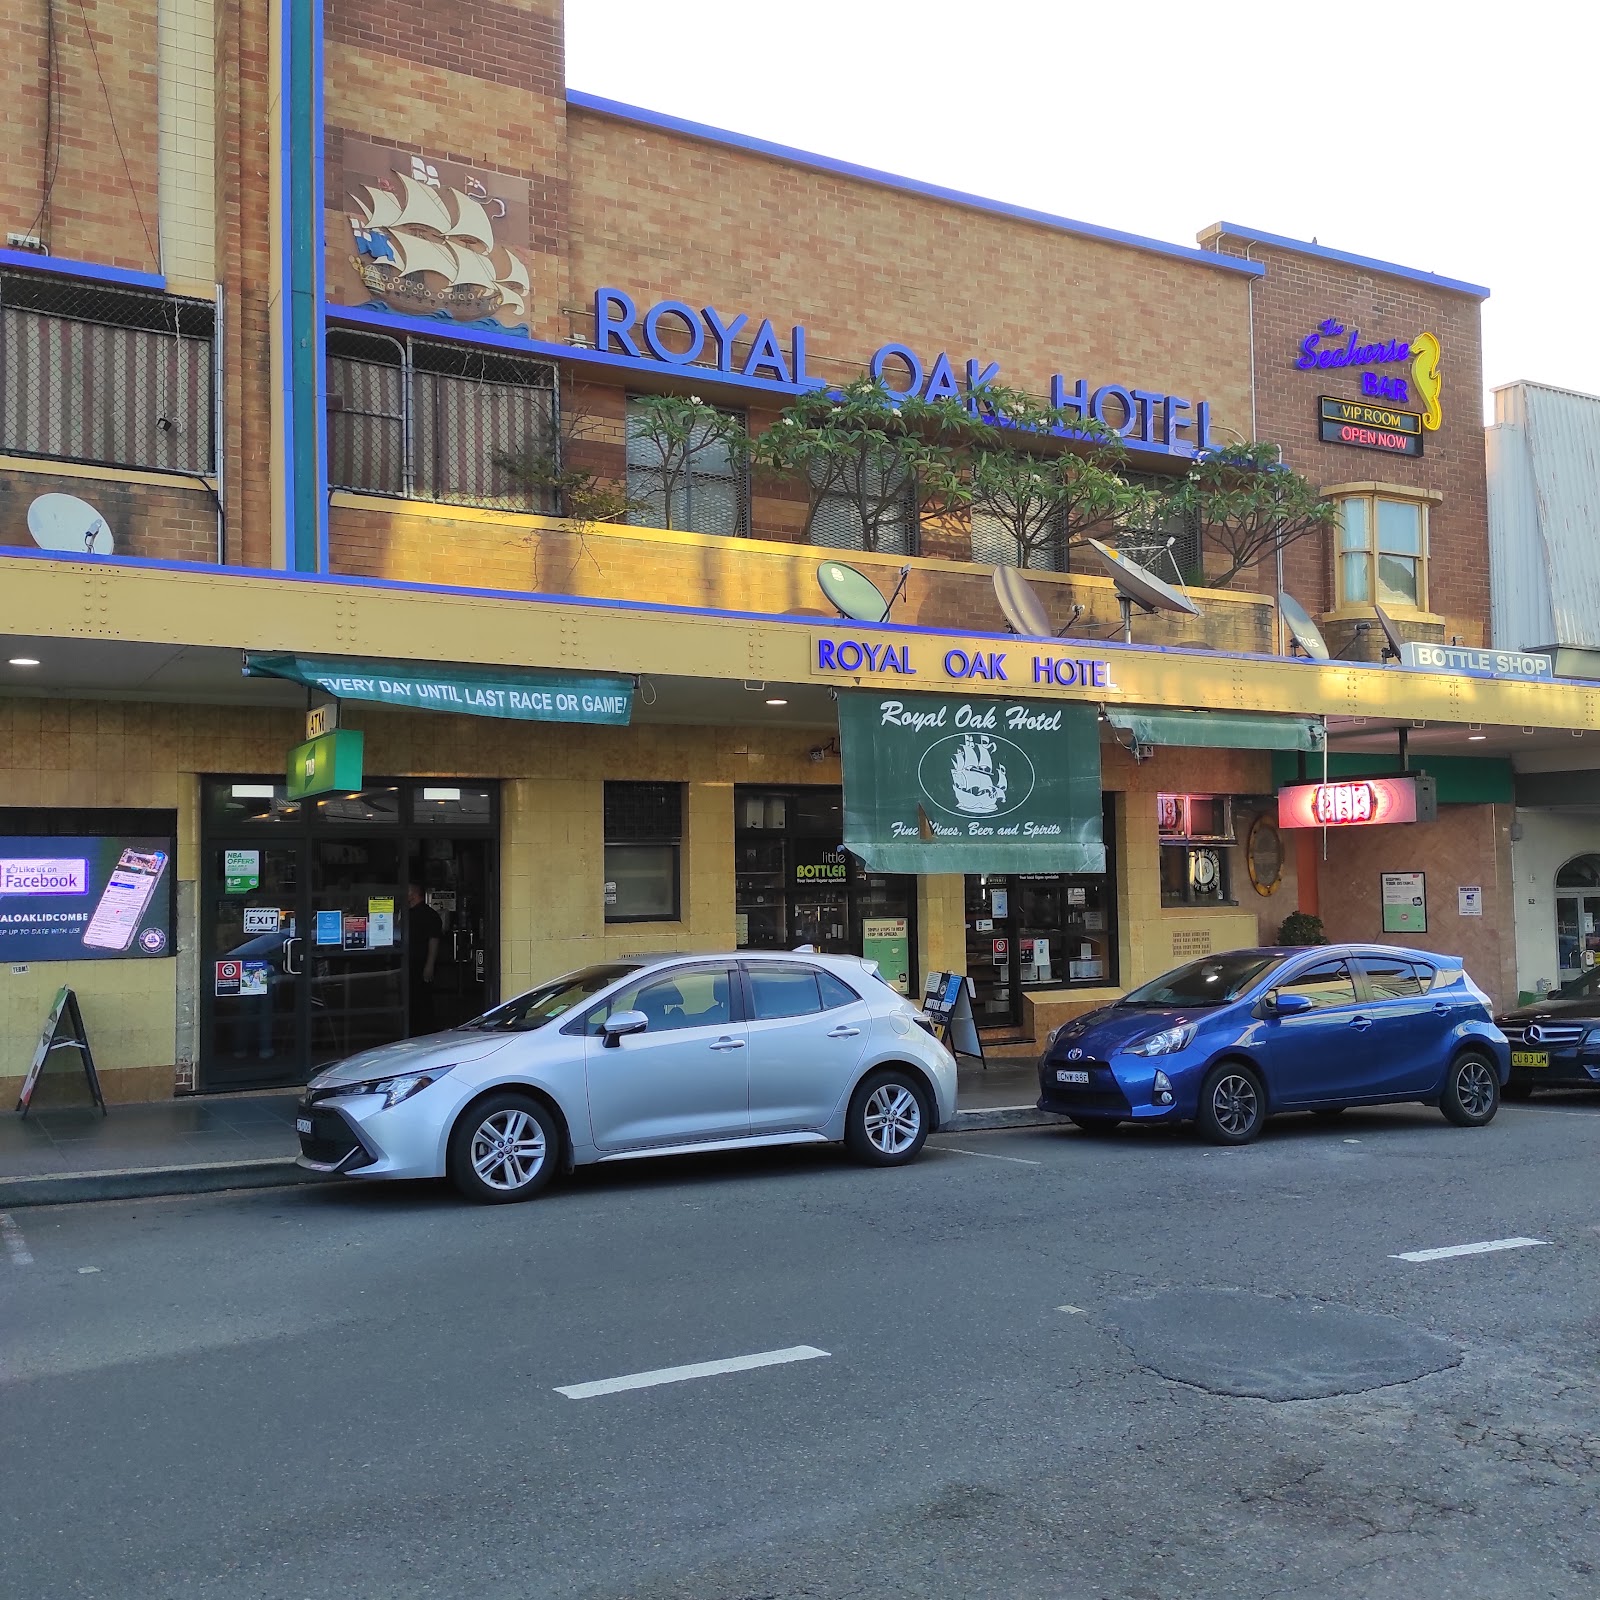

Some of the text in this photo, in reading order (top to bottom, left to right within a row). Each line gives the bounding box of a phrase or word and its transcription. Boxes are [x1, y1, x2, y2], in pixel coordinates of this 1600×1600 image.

[1296, 330, 1410, 369] Seahorse
[595, 287, 1225, 454] ROYAL OAK HOTEL
[1362, 371, 1409, 403] BAR
[1342, 404, 1401, 427] VIP ROOM
[1341, 425, 1407, 449] OPEN NOW
[818, 639, 1118, 688] ROYAL OAK HOTEL
[1417, 648, 1547, 676] BOTTLE SHOP
[316, 678, 627, 714] EVERY DAY UNTIL LAST RACE OR GAME!
[309, 711, 325, 736] ATM
[880, 700, 1062, 732] Royal Oak Hotel
[891, 821, 918, 839] Fine
[968, 821, 994, 836] Beer
[997, 822, 1020, 836] and
[1022, 821, 1062, 837] Spirits
[822, 851, 846, 863] little
[6, 873, 77, 888] Facebook
[797, 865, 846, 877] BOTTLER
[249, 916, 276, 925] EXIT
[1513, 1053, 1523, 1064] CU
